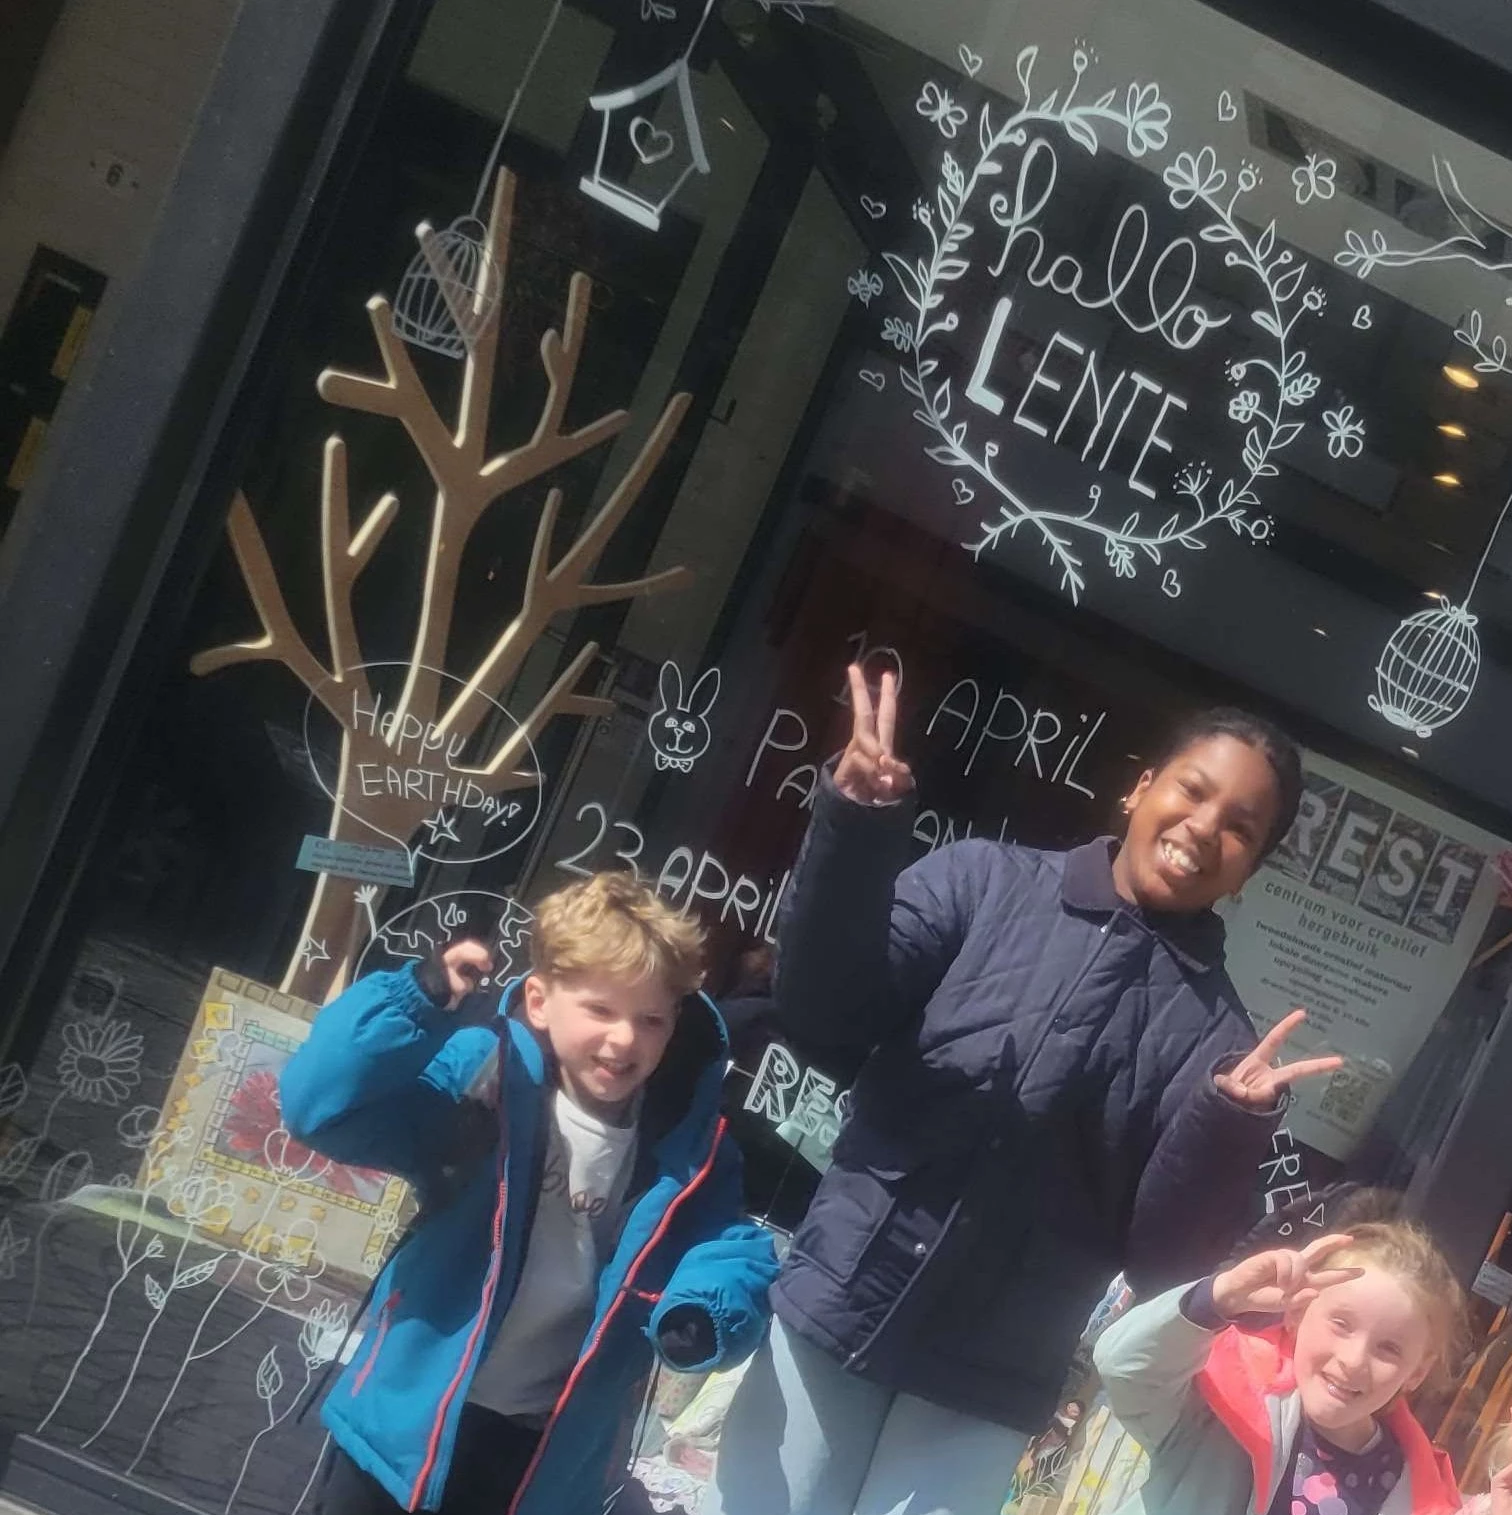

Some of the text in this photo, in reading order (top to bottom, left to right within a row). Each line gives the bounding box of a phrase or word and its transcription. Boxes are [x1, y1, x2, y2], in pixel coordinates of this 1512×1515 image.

[989, 138, 1231, 349] hallo
[965, 297, 1187, 498] LENTE
[555, 802, 644, 883] 23
[1282, 788, 1476, 919] REST
[1262, 877, 1429, 962] centrum voor creatief
[1295, 910, 1381, 964] hergebruik
